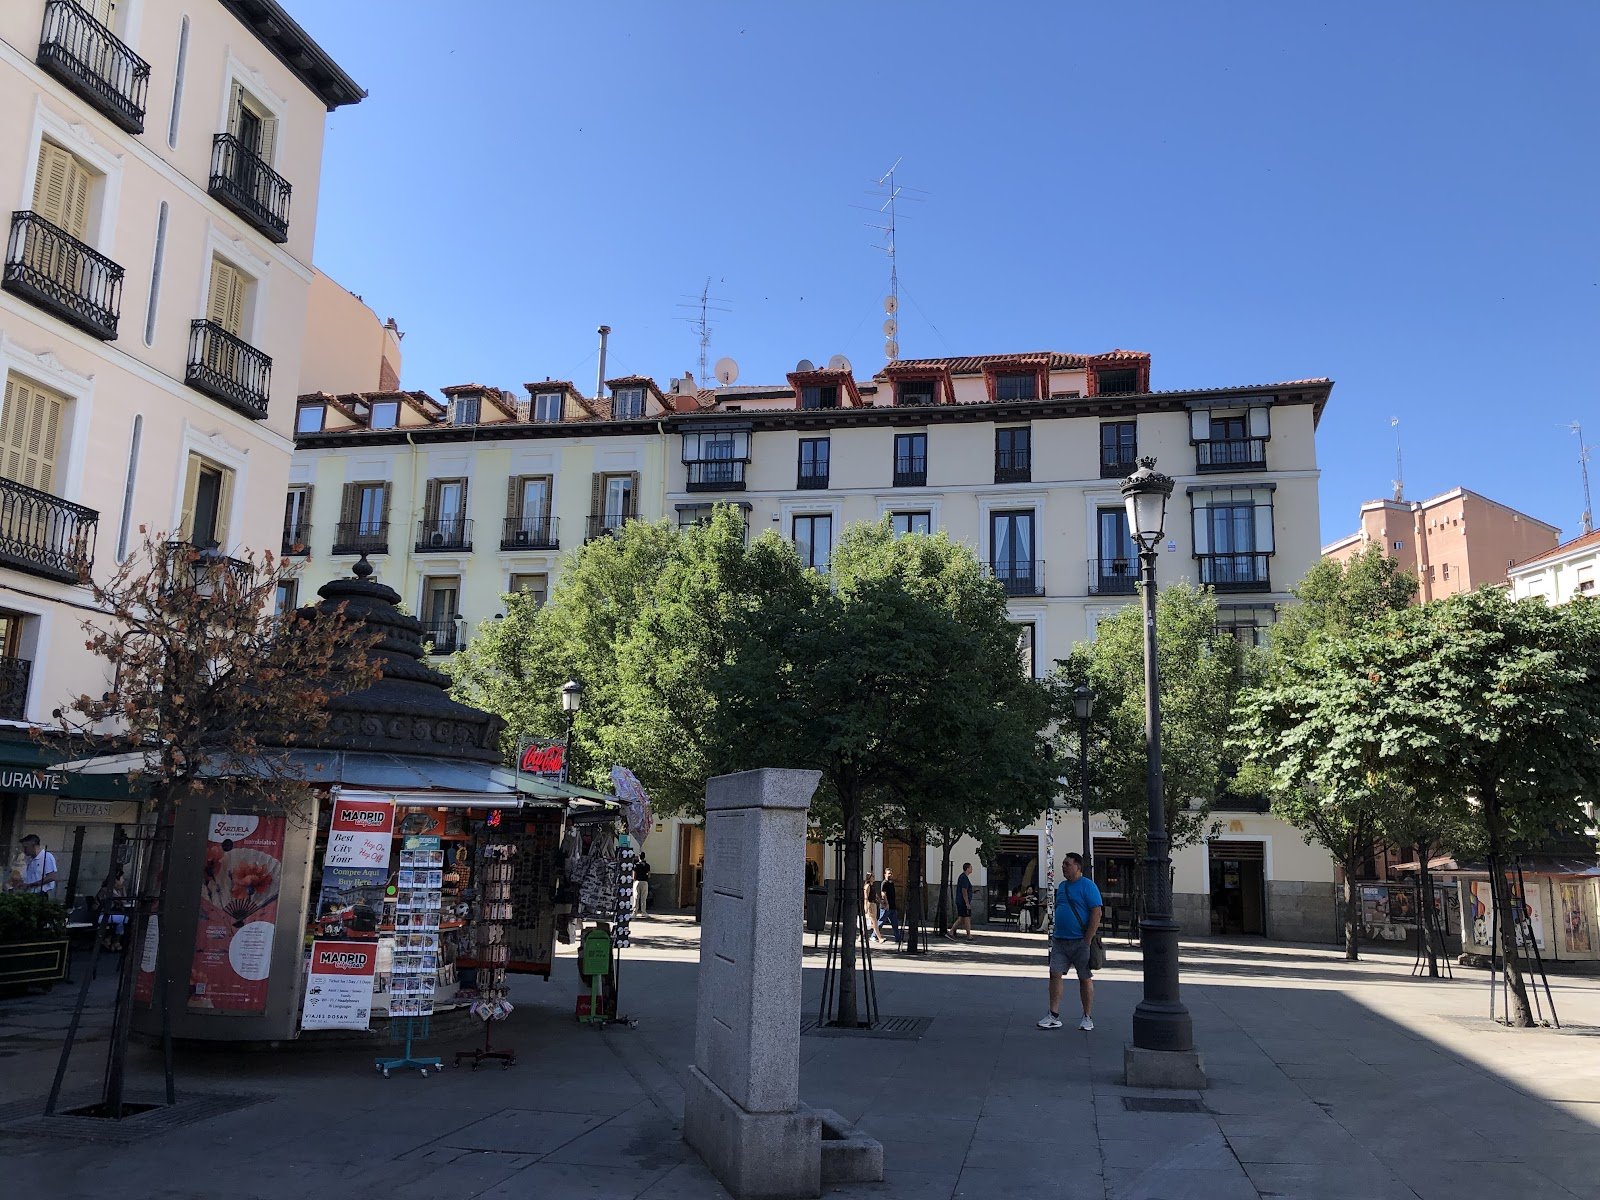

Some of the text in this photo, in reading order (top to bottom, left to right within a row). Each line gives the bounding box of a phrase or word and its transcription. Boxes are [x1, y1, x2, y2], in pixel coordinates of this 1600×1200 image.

[0, 771, 60, 790] URANTE
[341, 810, 385, 822] MADRID
[214, 821, 249, 836] ZARZUELA
[334, 833, 354, 842] Best
[333, 844, 352, 855] City
[363, 838, 385, 852] Hop On
[330, 854, 352, 863] Tour
[359, 848, 384, 863] Hop Off
[333, 868, 361, 877] Compre
[321, 952, 367, 965] MADRID
